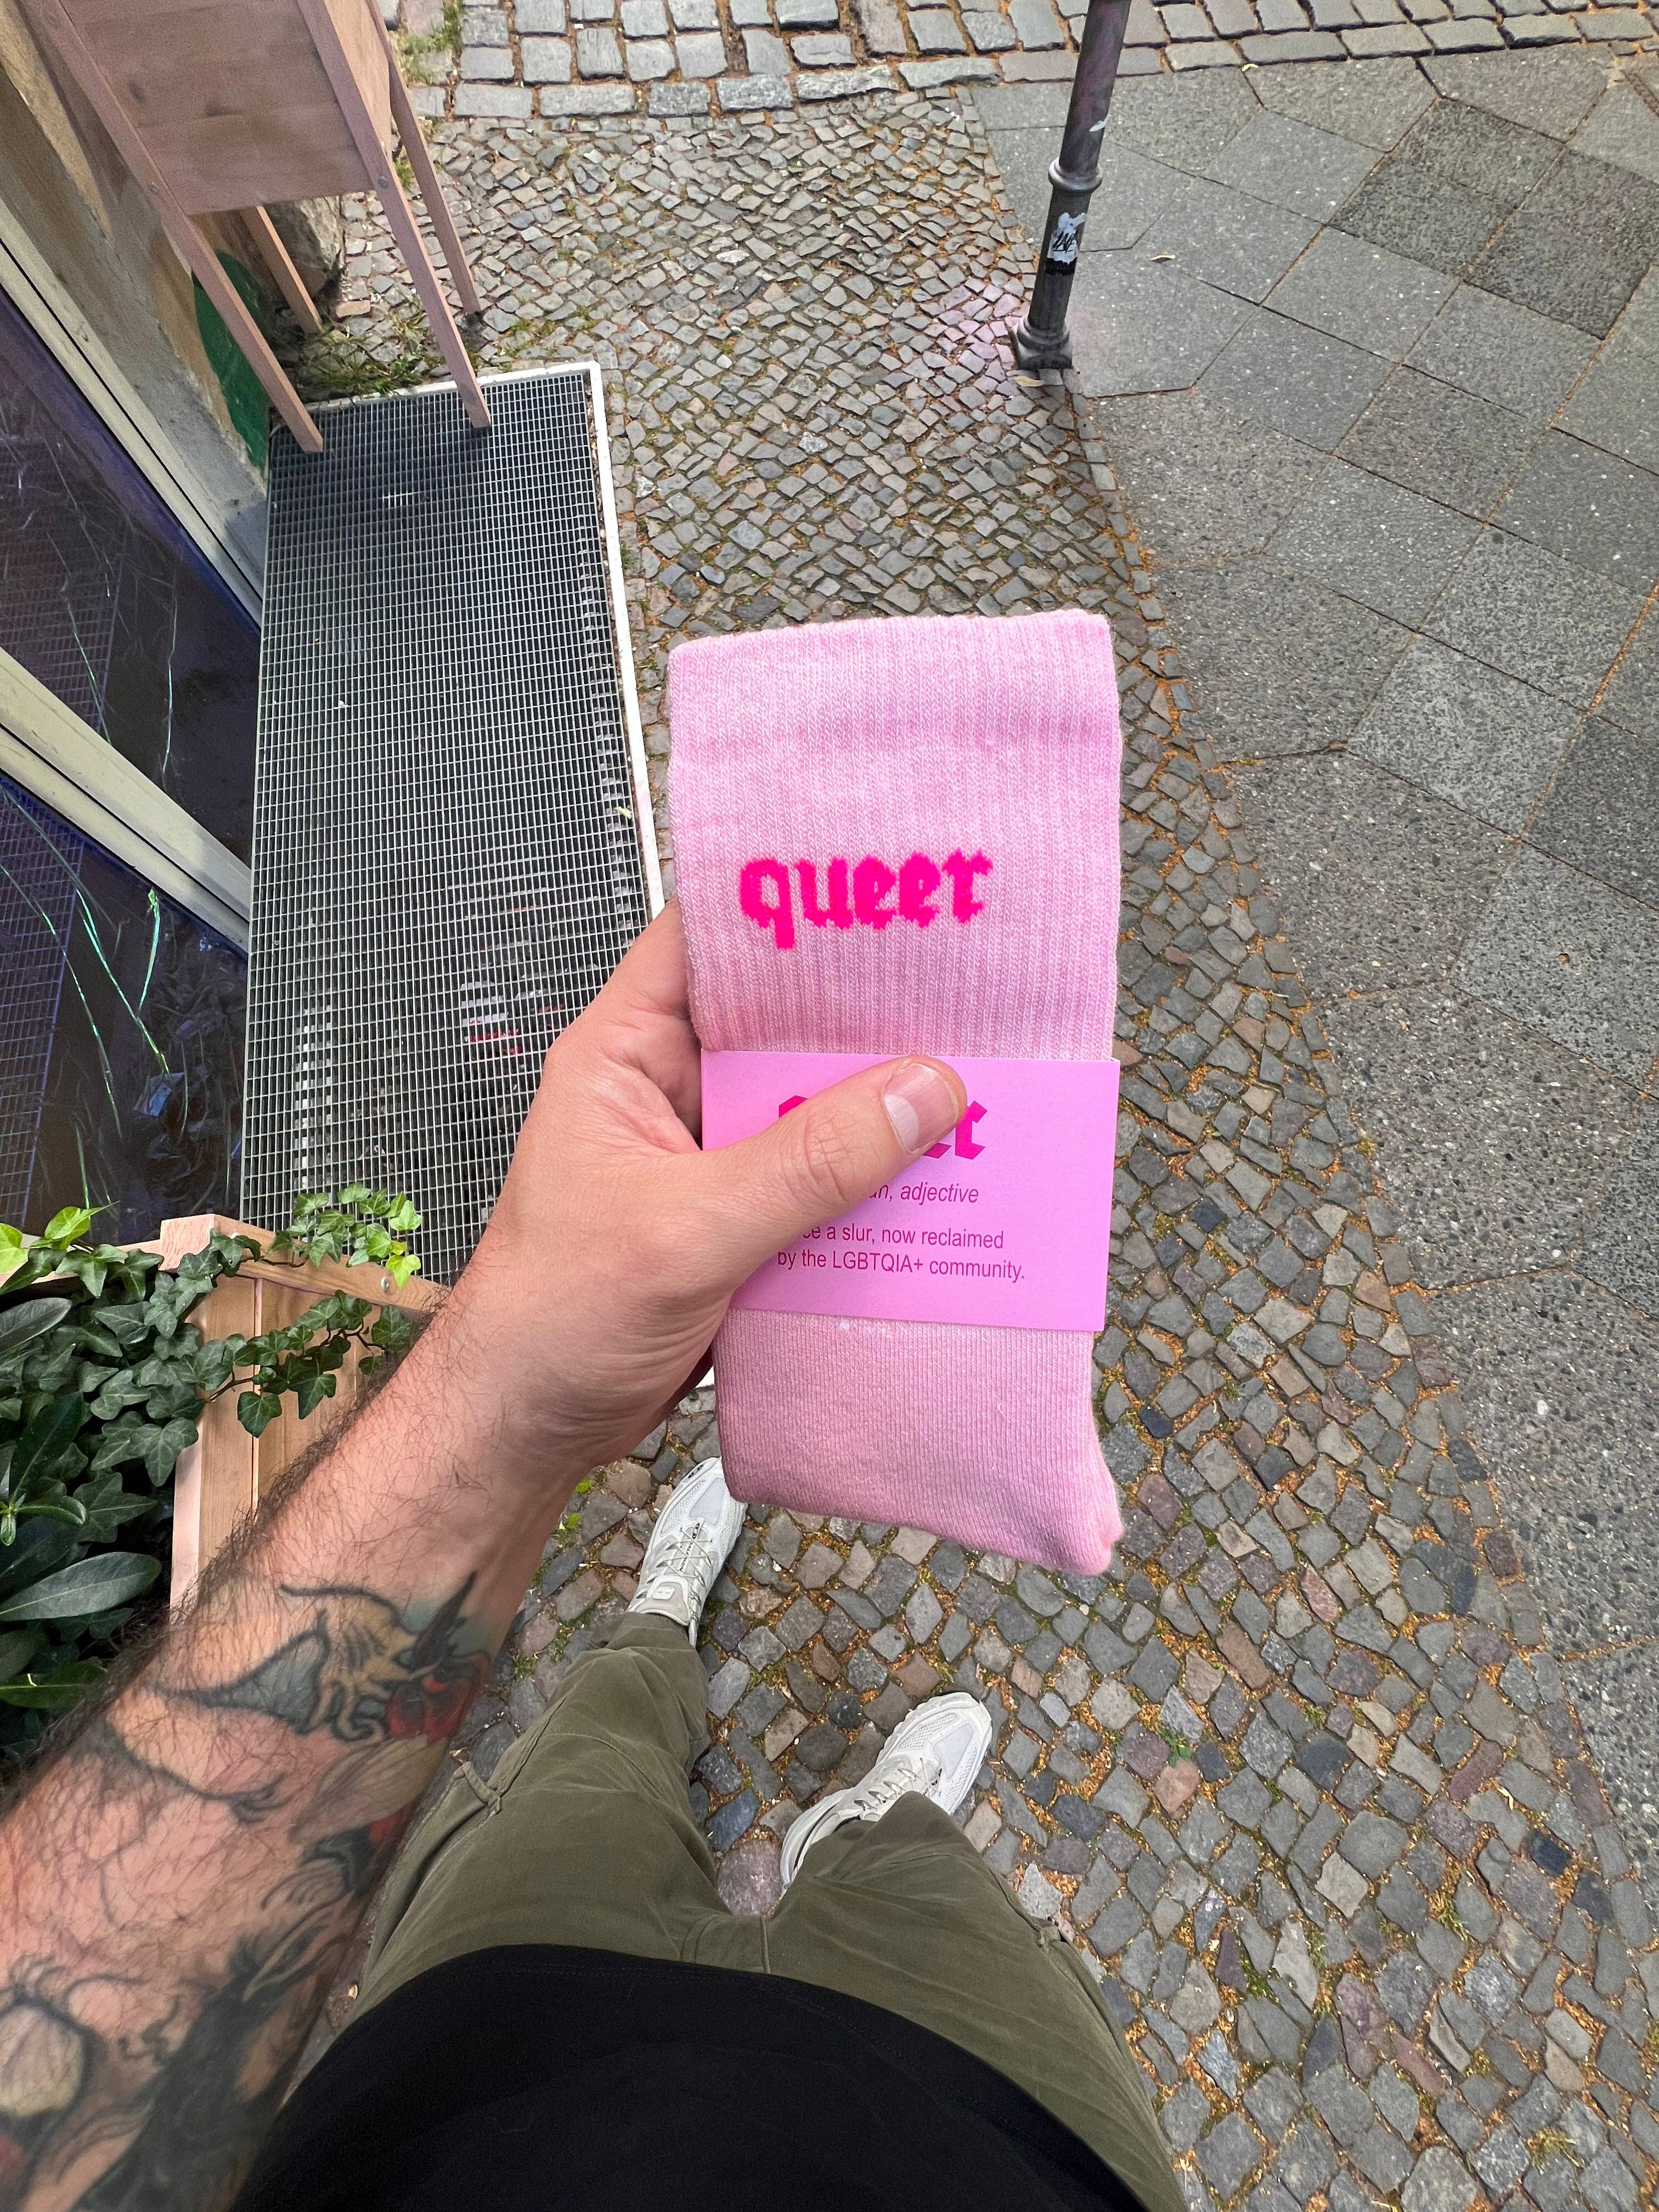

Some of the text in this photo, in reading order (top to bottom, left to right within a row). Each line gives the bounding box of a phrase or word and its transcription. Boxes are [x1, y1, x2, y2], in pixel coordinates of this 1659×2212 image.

[740, 849, 992, 950] queer
[900, 1181, 979, 1205] adjective
[827, 1226, 836, 1240] a
[842, 1223, 875, 1245] slur,
[882, 1228, 916, 1244] now
[922, 1228, 1004, 1249] reclaimed
[778, 1249, 1025, 1283] by the LGBTQIA+ community.
